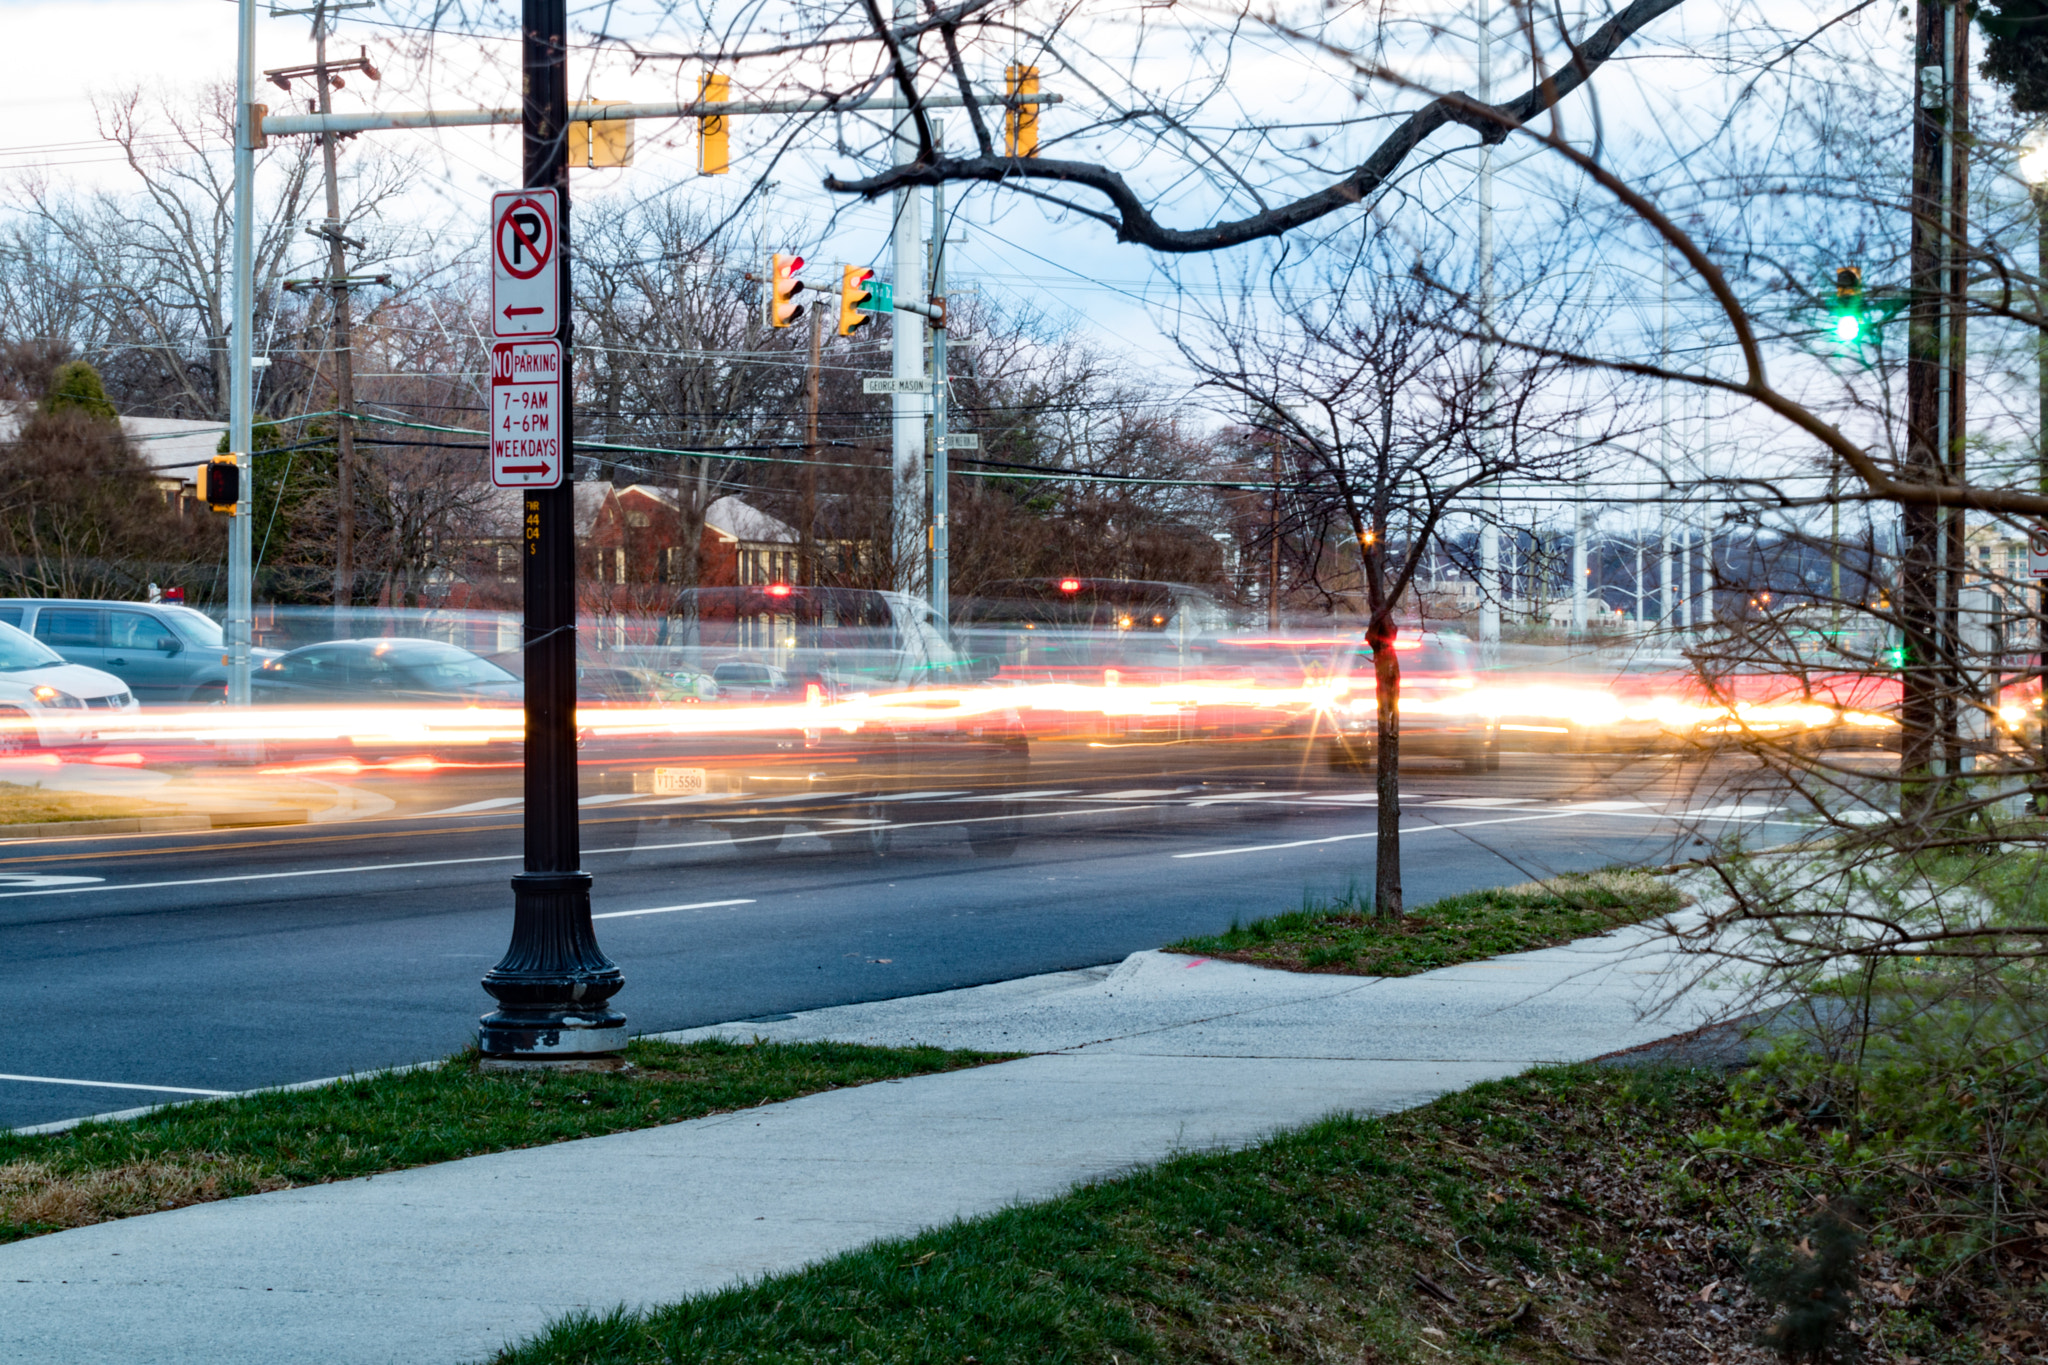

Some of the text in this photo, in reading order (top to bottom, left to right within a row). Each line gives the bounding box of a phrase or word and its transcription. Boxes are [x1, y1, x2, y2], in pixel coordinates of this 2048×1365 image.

[513, 213, 541, 265] P
[493, 350, 556, 378] NO PARKING
[870, 380, 896, 391] GEORGE
[899, 380, 924, 391] MASON
[495, 438, 557, 458] WEEKDAYS
[526, 513, 540, 526] 44
[530, 543, 536, 555] S
